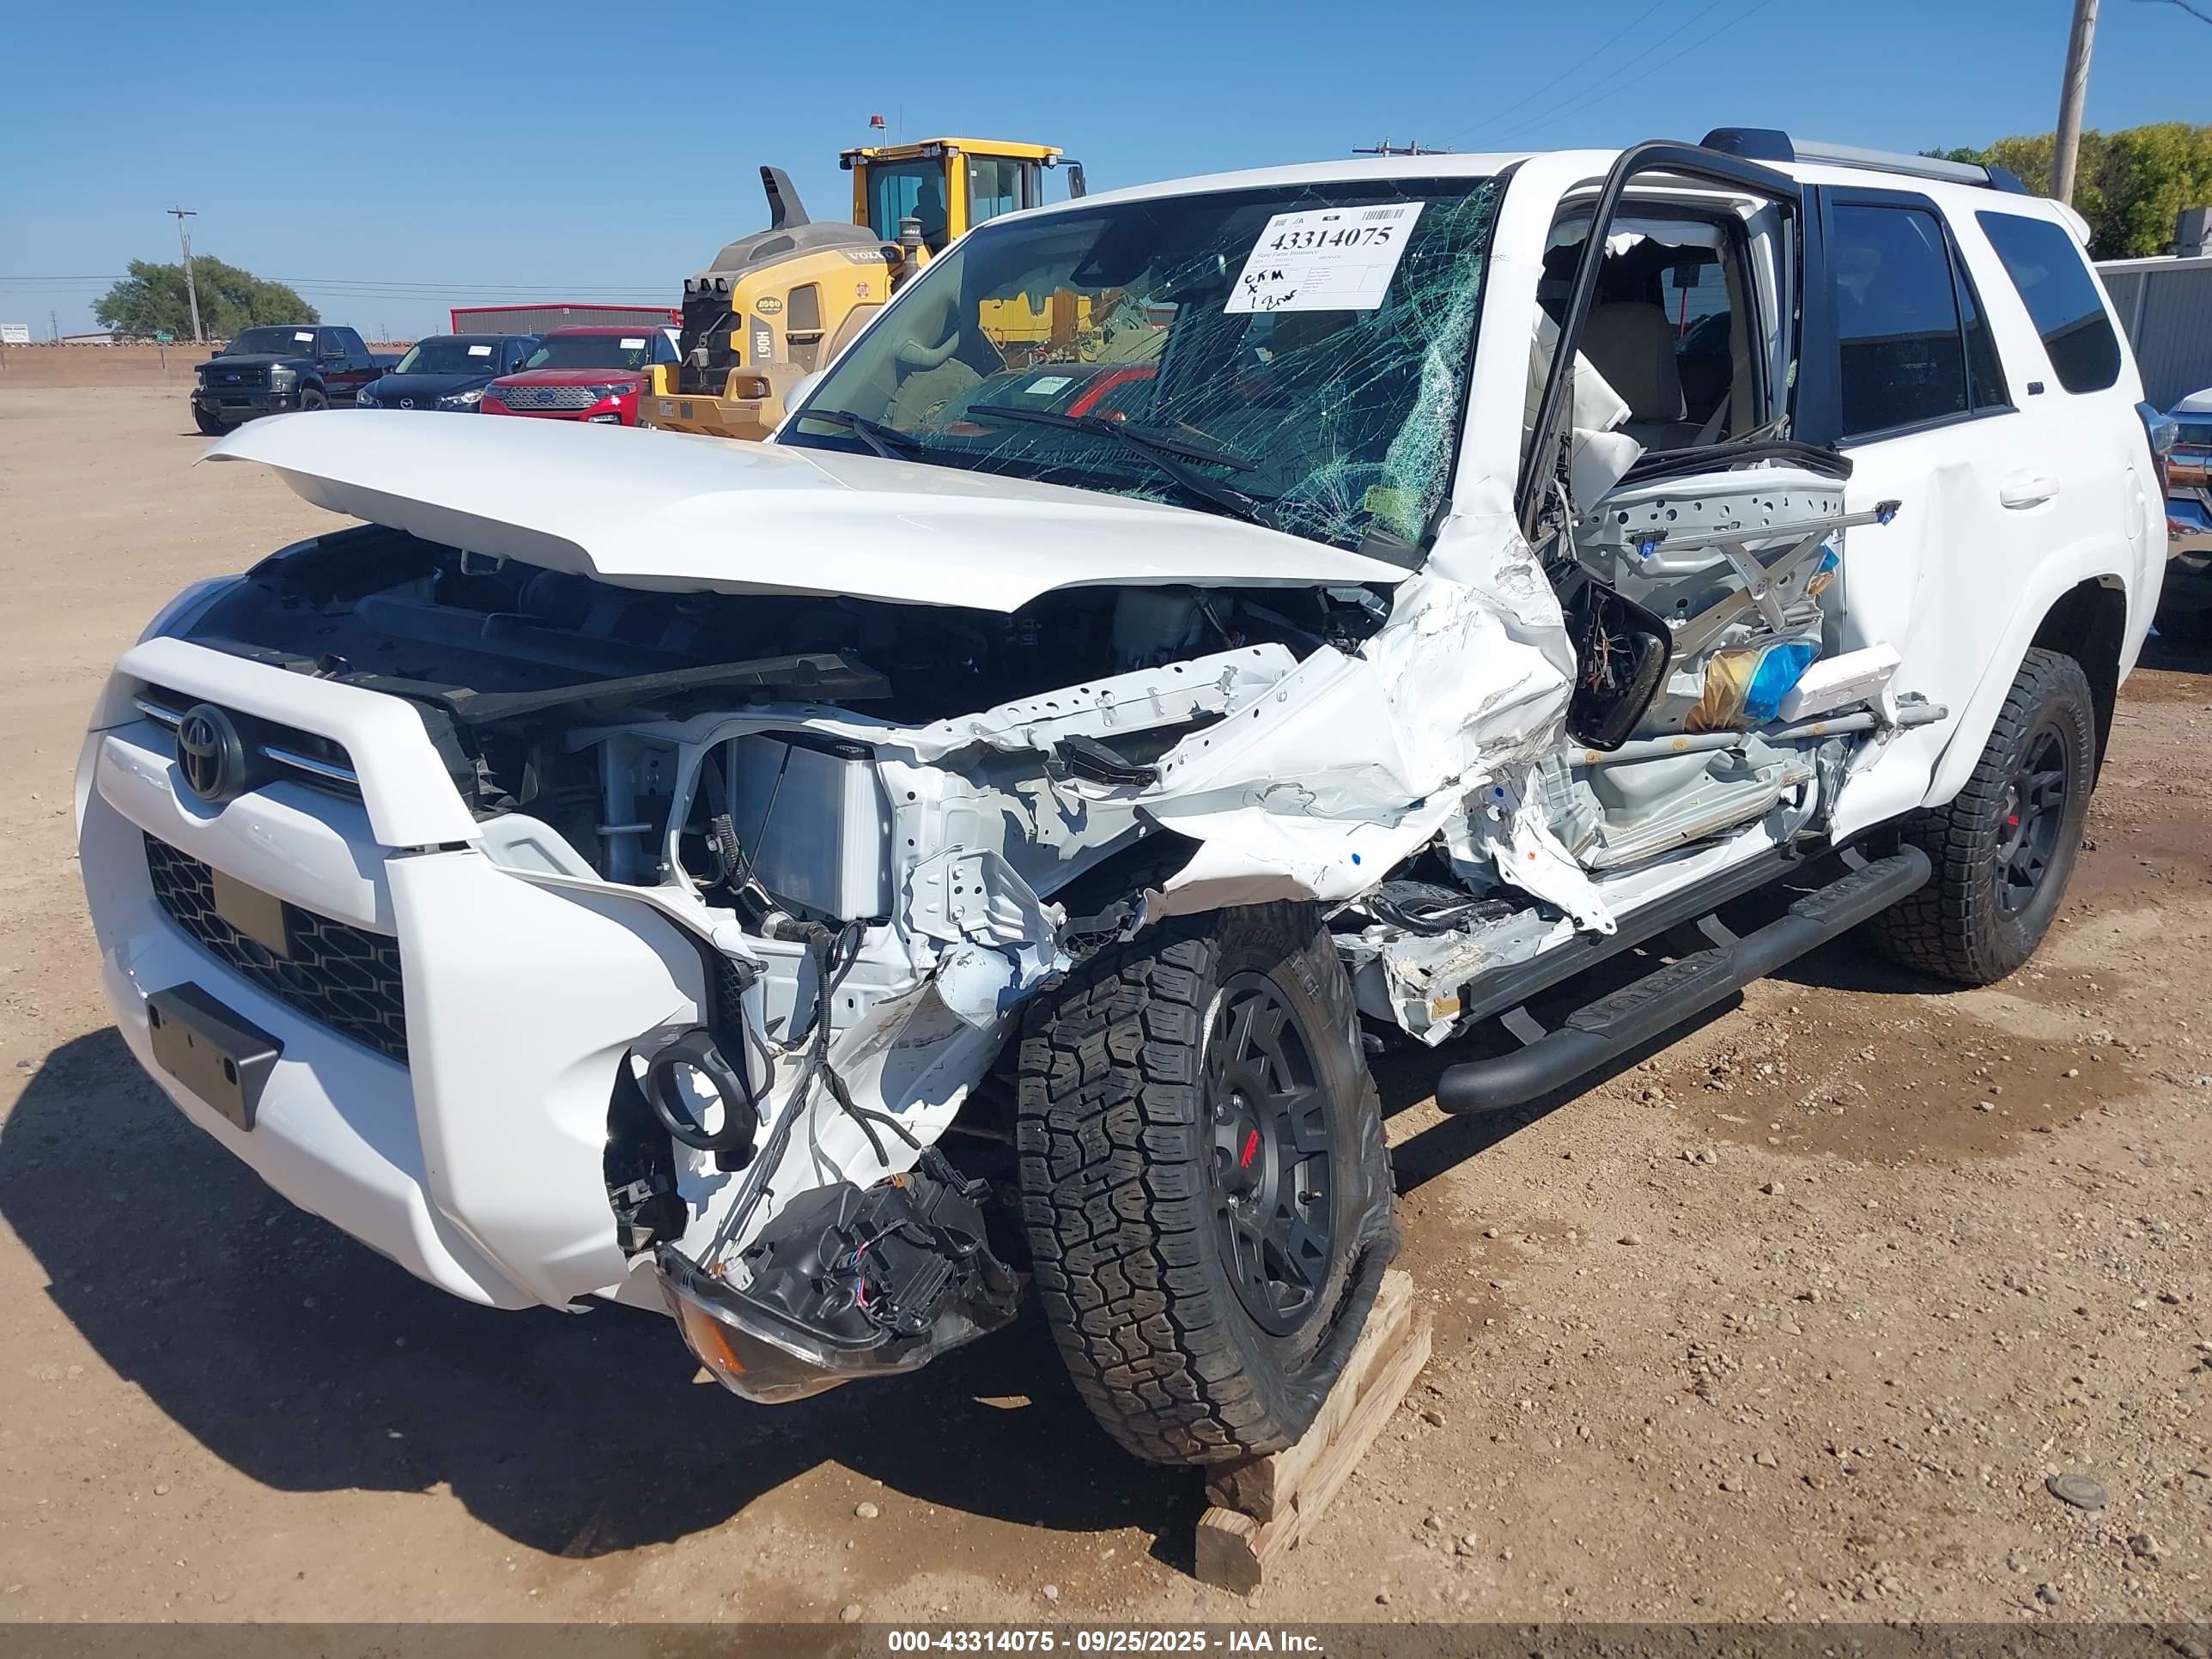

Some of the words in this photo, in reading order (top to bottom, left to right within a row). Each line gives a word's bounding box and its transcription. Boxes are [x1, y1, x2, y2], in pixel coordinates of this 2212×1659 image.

[1270, 227, 1395, 250] 43314075
[848, 251, 894, 259] VOLVO
[755, 331, 771, 358] L90H
